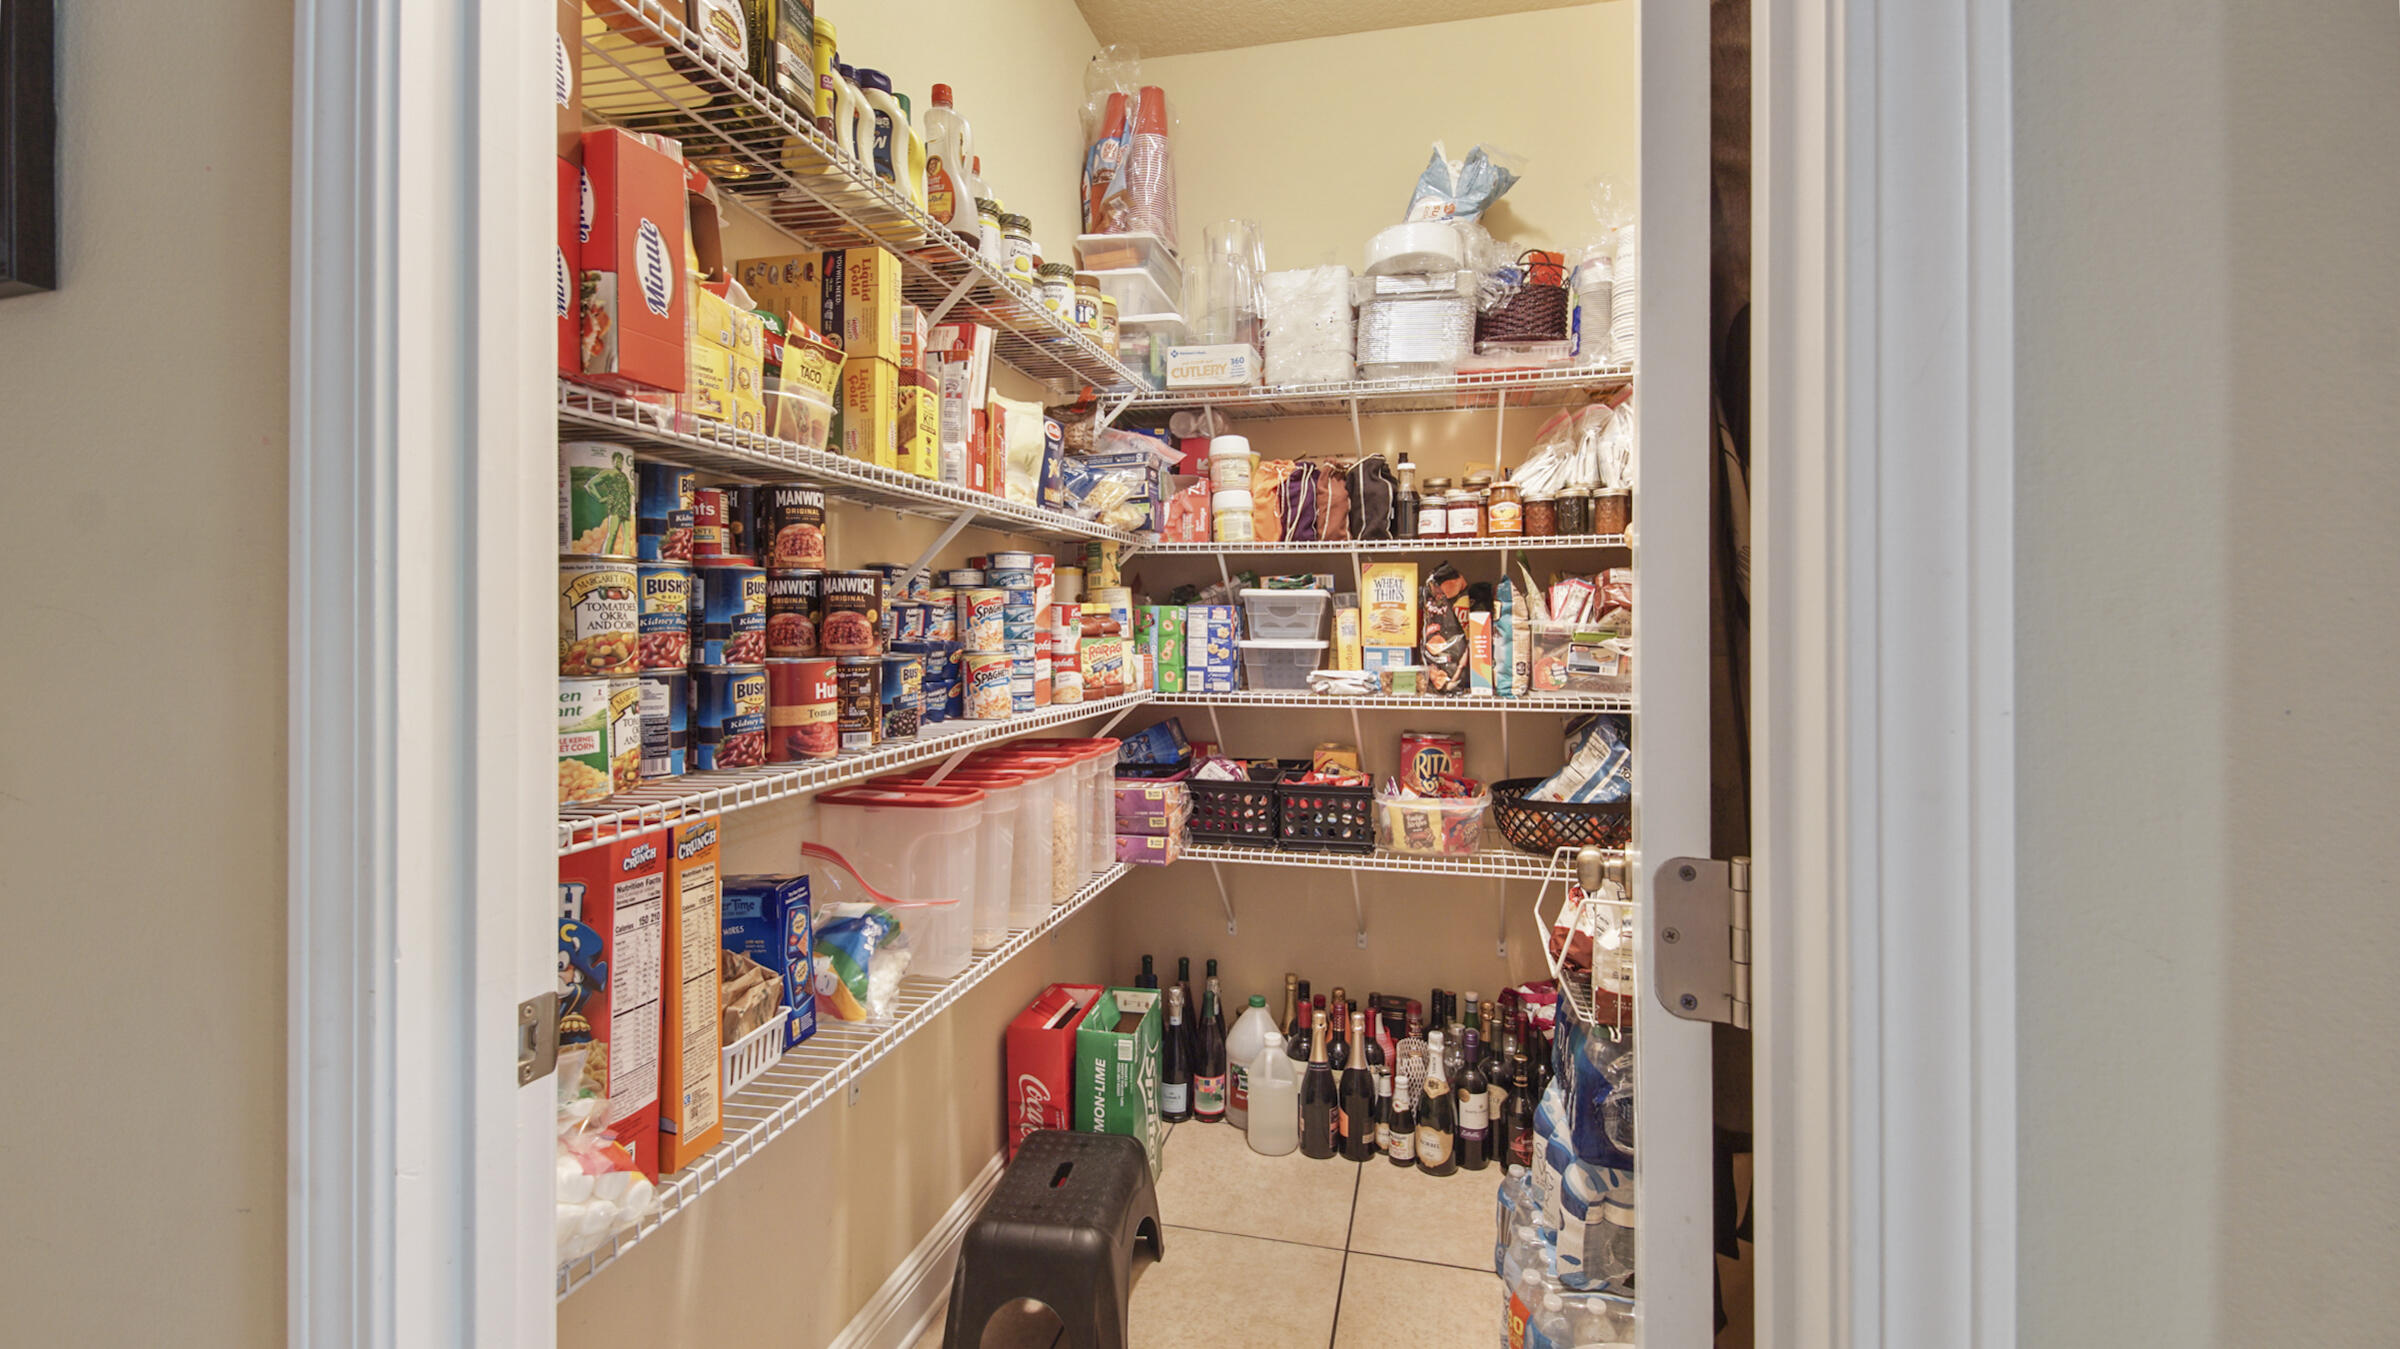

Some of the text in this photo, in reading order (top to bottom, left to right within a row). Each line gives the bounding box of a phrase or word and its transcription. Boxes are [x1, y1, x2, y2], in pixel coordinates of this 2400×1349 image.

[641, 220, 668, 315] Minute
[849, 264, 861, 296] Gold
[861, 258, 879, 302] Liquid
[800, 365, 822, 384] TACO
[1171, 363, 1227, 379] CUTLERY
[849, 375, 859, 407] Gold
[860, 368, 876, 413] Liquid
[775, 490, 825, 510] MANWIC
[785, 508, 820, 516] ORIGINAL
[646, 579, 690, 596] BUSH'S
[766, 580, 817, 597] MANWICH
[823, 577, 876, 597] MANWICH
[1373, 578, 1405, 590] WHEAT
[1375, 589, 1405, 602] THINS
[600, 611, 628, 620] OKRA
[587, 621, 612, 630] AND
[559, 704, 583, 717] ant
[730, 719, 759, 729] Kidney
[568, 735, 594, 744] KERNEL
[571, 743, 594, 752] CORN
[1416, 752, 1449, 779] RITZ
[677, 830, 717, 861] CRUNCH
[623, 847, 657, 871] CRUNCH
[682, 869, 701, 878] Nutrition
[616, 877, 661, 893] Nutrition Facts
[731, 898, 755, 911] Time
[615, 911, 660, 933] Calories 150 210
[723, 925, 745, 936] MORES
[1093, 1058, 1107, 1132] MON-LIME
